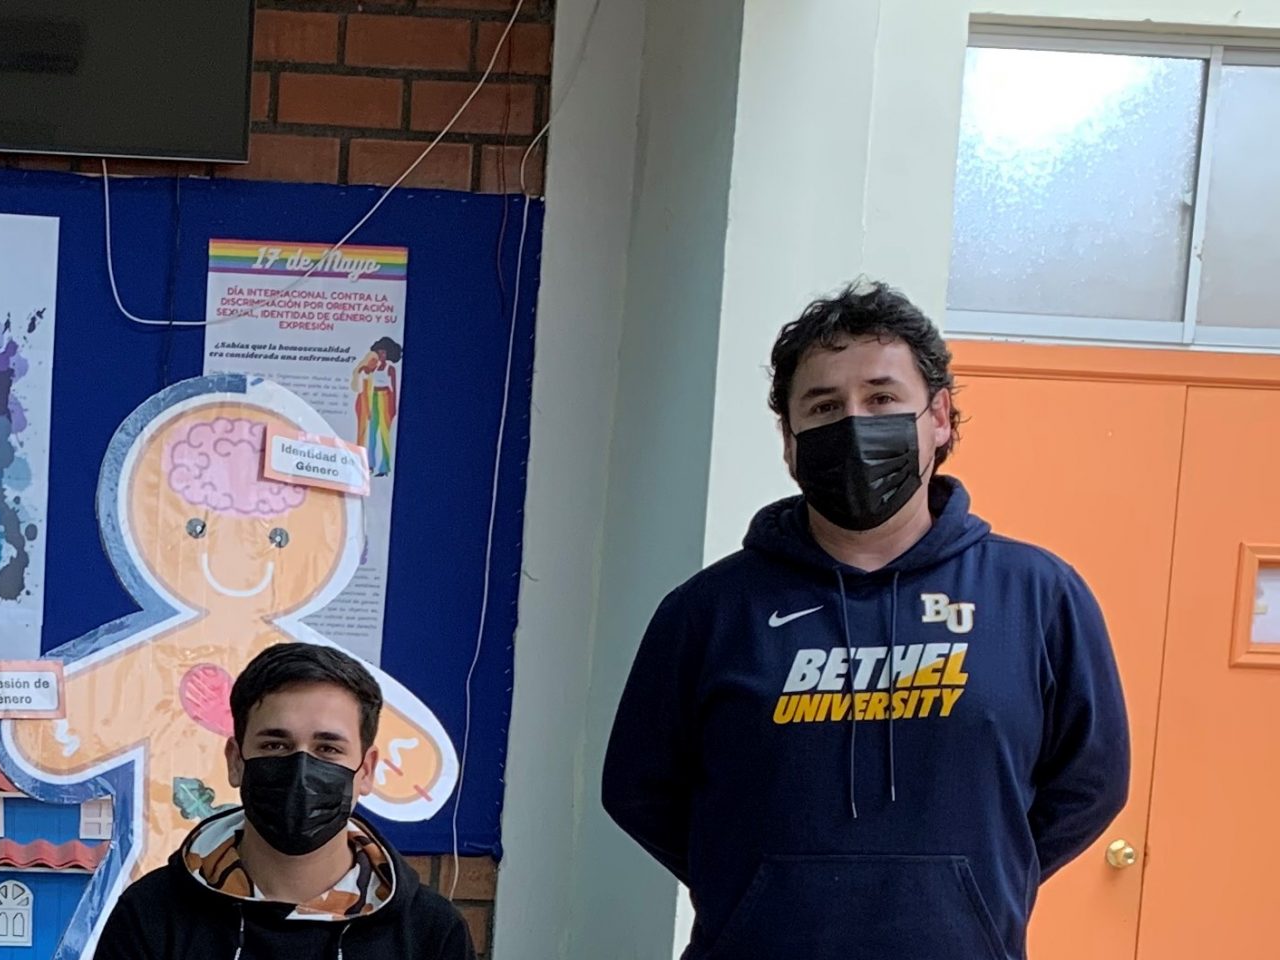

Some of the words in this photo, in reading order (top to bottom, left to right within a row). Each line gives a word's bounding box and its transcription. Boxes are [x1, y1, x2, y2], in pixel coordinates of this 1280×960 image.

[252, 247, 281, 269] 17
[286, 248, 314, 271] de
[316, 249, 381, 282] Mayo
[227, 285, 245, 297] DÍA
[247, 288, 327, 300] INTERNACIONAL
[330, 291, 372, 302] CONTRA
[374, 294, 388, 303] LA
[303, 301, 324, 310] POR
[326, 301, 395, 314] ORIENTACIÓN
[260, 309, 314, 321] IDENTIDAD
[317, 311, 330, 321] DE
[333, 311, 372, 323] GÉNERO
[376, 314, 383, 323] Y
[384, 315, 398, 324] SU
[278, 319, 334, 331] EXPRESIÓN
[214, 341, 249, 350] ¿Sabías
[251, 343, 267, 351] que
[278, 343, 351, 354] homosexualidad
[225, 351, 278, 360] considerada
[298, 354, 357, 363] enfermedad?
[280, 443, 337, 463] Identidad
[295, 461, 339, 477] Género
[920, 592, 976, 634] BU
[783, 642, 969, 694] BETHEL
[34, 678, 50, 689] de
[772, 688, 965, 726] UNIVERSITY
